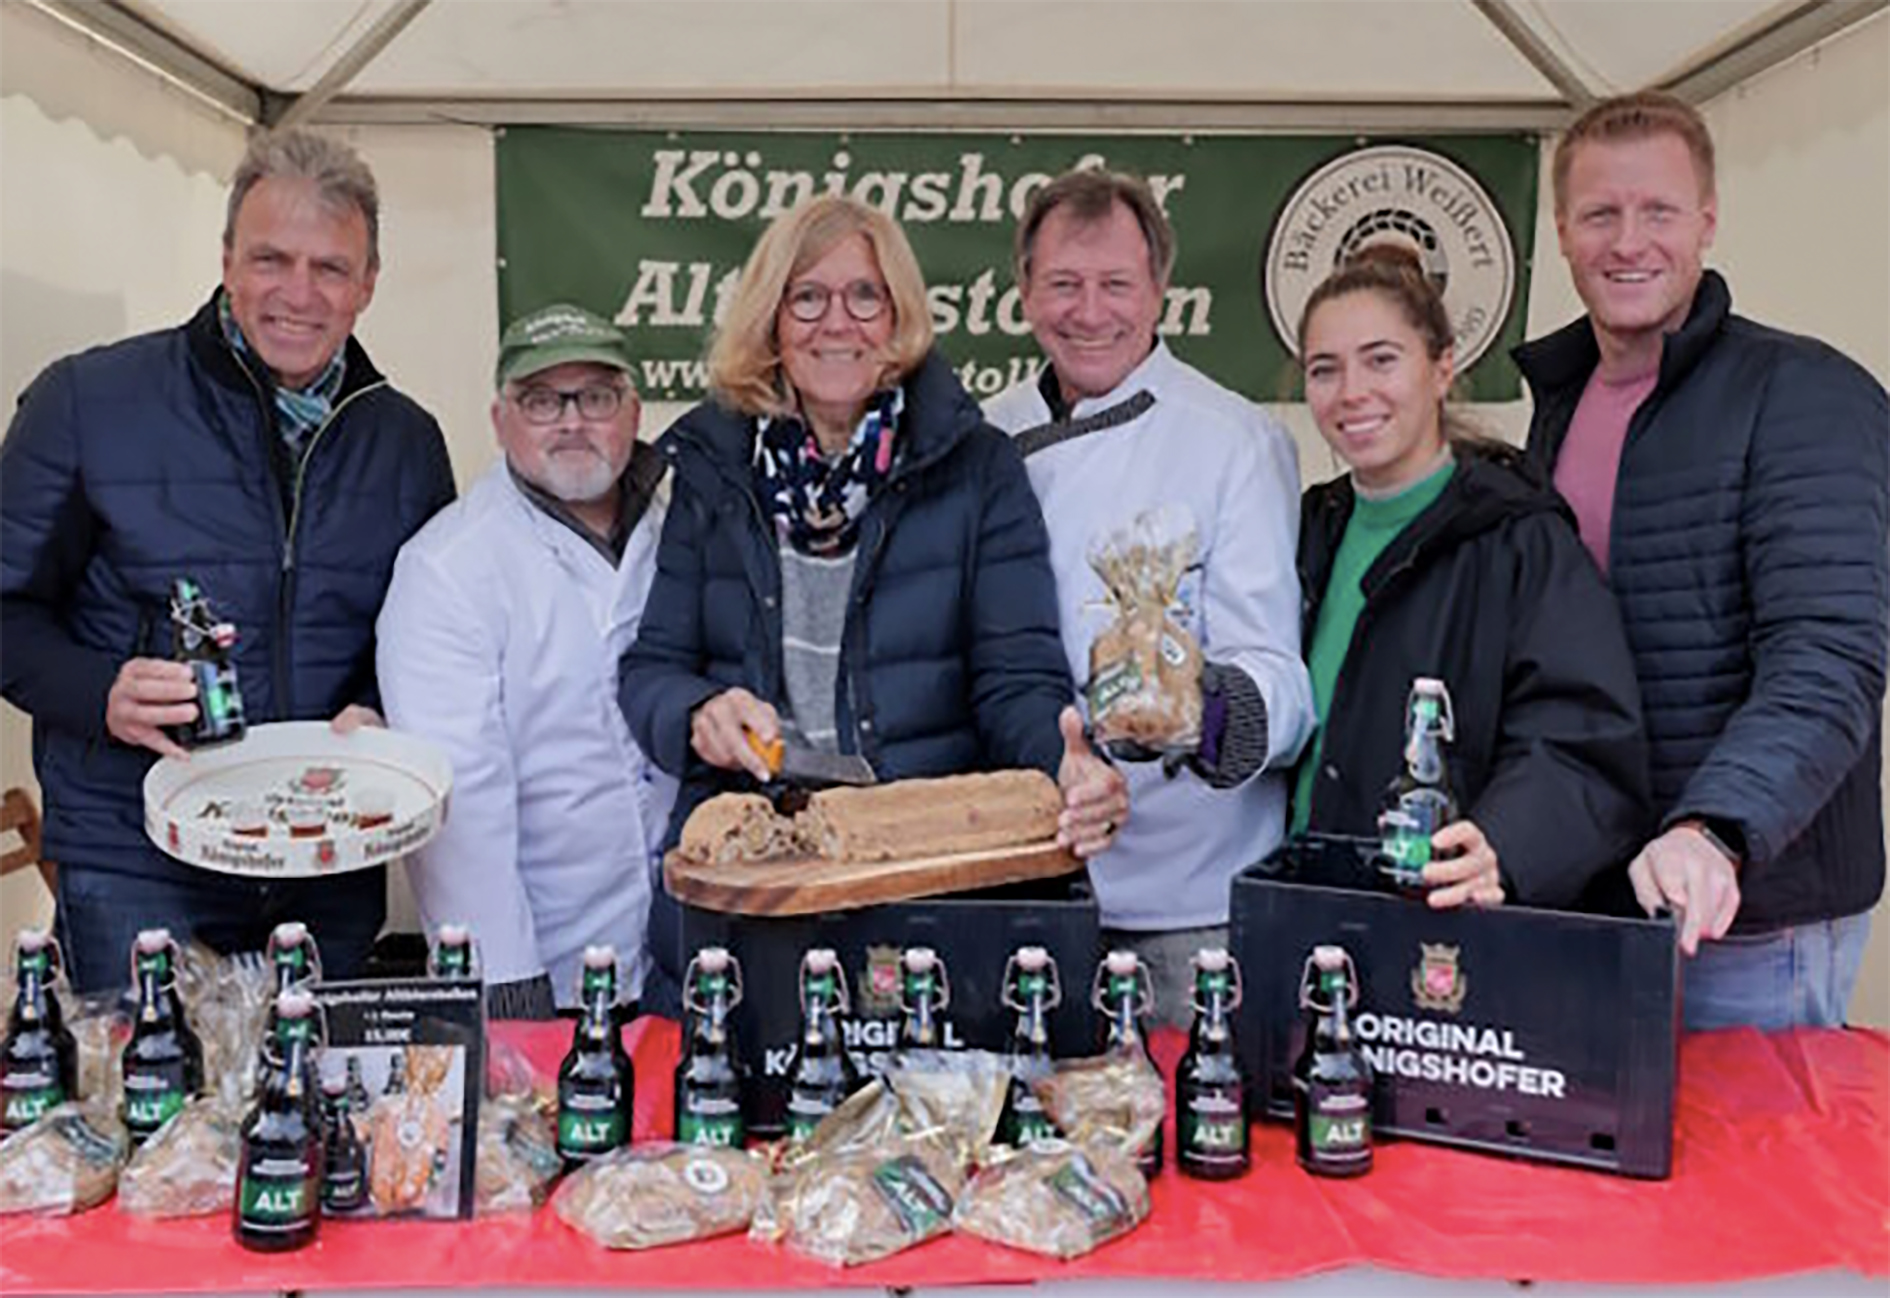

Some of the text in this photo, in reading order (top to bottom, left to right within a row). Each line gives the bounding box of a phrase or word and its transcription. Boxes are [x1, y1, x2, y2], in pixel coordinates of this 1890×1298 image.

[1283, 163, 1494, 272] Bäckerei Weißert
[1355, 1012, 1525, 1060] ORIGINAL
[1361, 1044, 1566, 1098] NIGSHOFER
[5, 1099, 47, 1119] ALT
[130, 1102, 163, 1121] ALT
[570, 1122, 611, 1142] ALT
[694, 1124, 734, 1145] ALT
[1193, 1124, 1234, 1144] ALT
[1325, 1121, 1365, 1143] ALT
[254, 1189, 304, 1212] ALT
